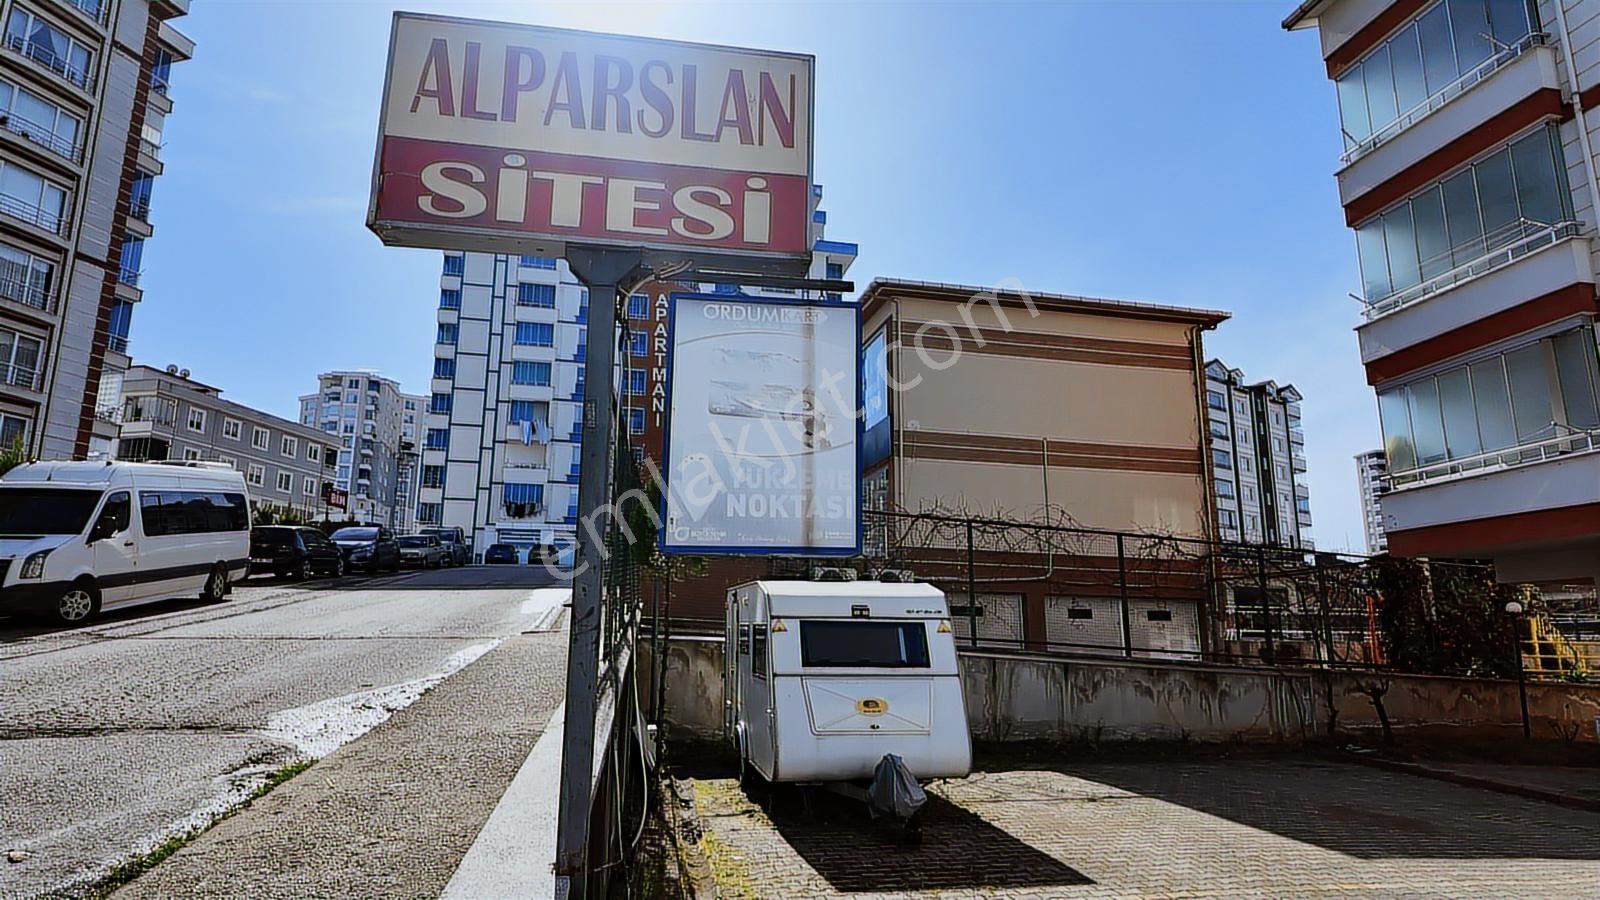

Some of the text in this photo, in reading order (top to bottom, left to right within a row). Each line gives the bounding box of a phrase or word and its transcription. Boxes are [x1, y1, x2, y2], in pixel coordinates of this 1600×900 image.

[410, 38, 796, 149] ALPARSLAN
[652, 293, 669, 427] APARTMANI
[726, 492, 854, 520] NOKTASI
